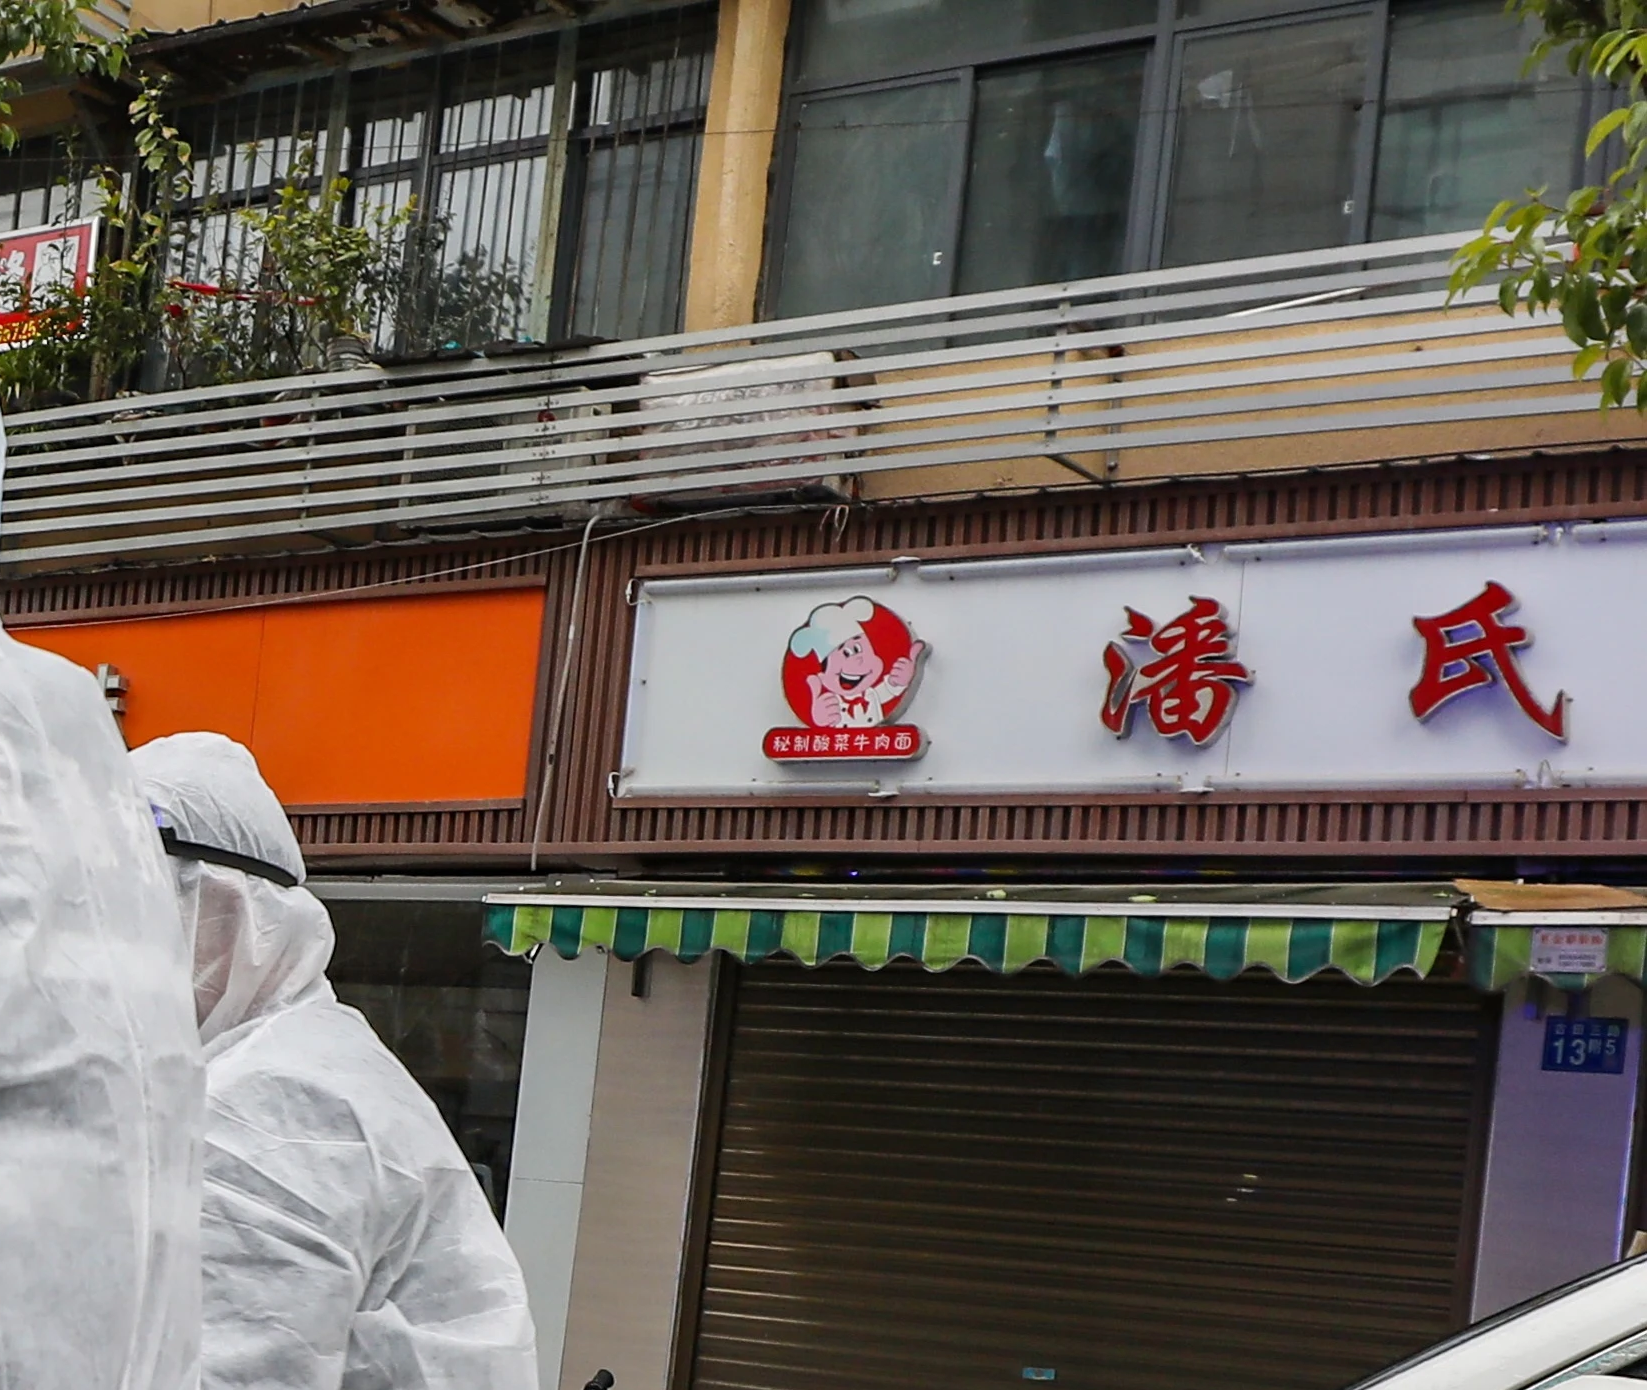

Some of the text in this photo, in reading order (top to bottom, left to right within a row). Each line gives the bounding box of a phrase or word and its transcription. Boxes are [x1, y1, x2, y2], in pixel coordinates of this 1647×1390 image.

[1100, 580, 1571, 749] 潘氏
[773, 732, 912, 752] 秘制酸菜牛肉面
